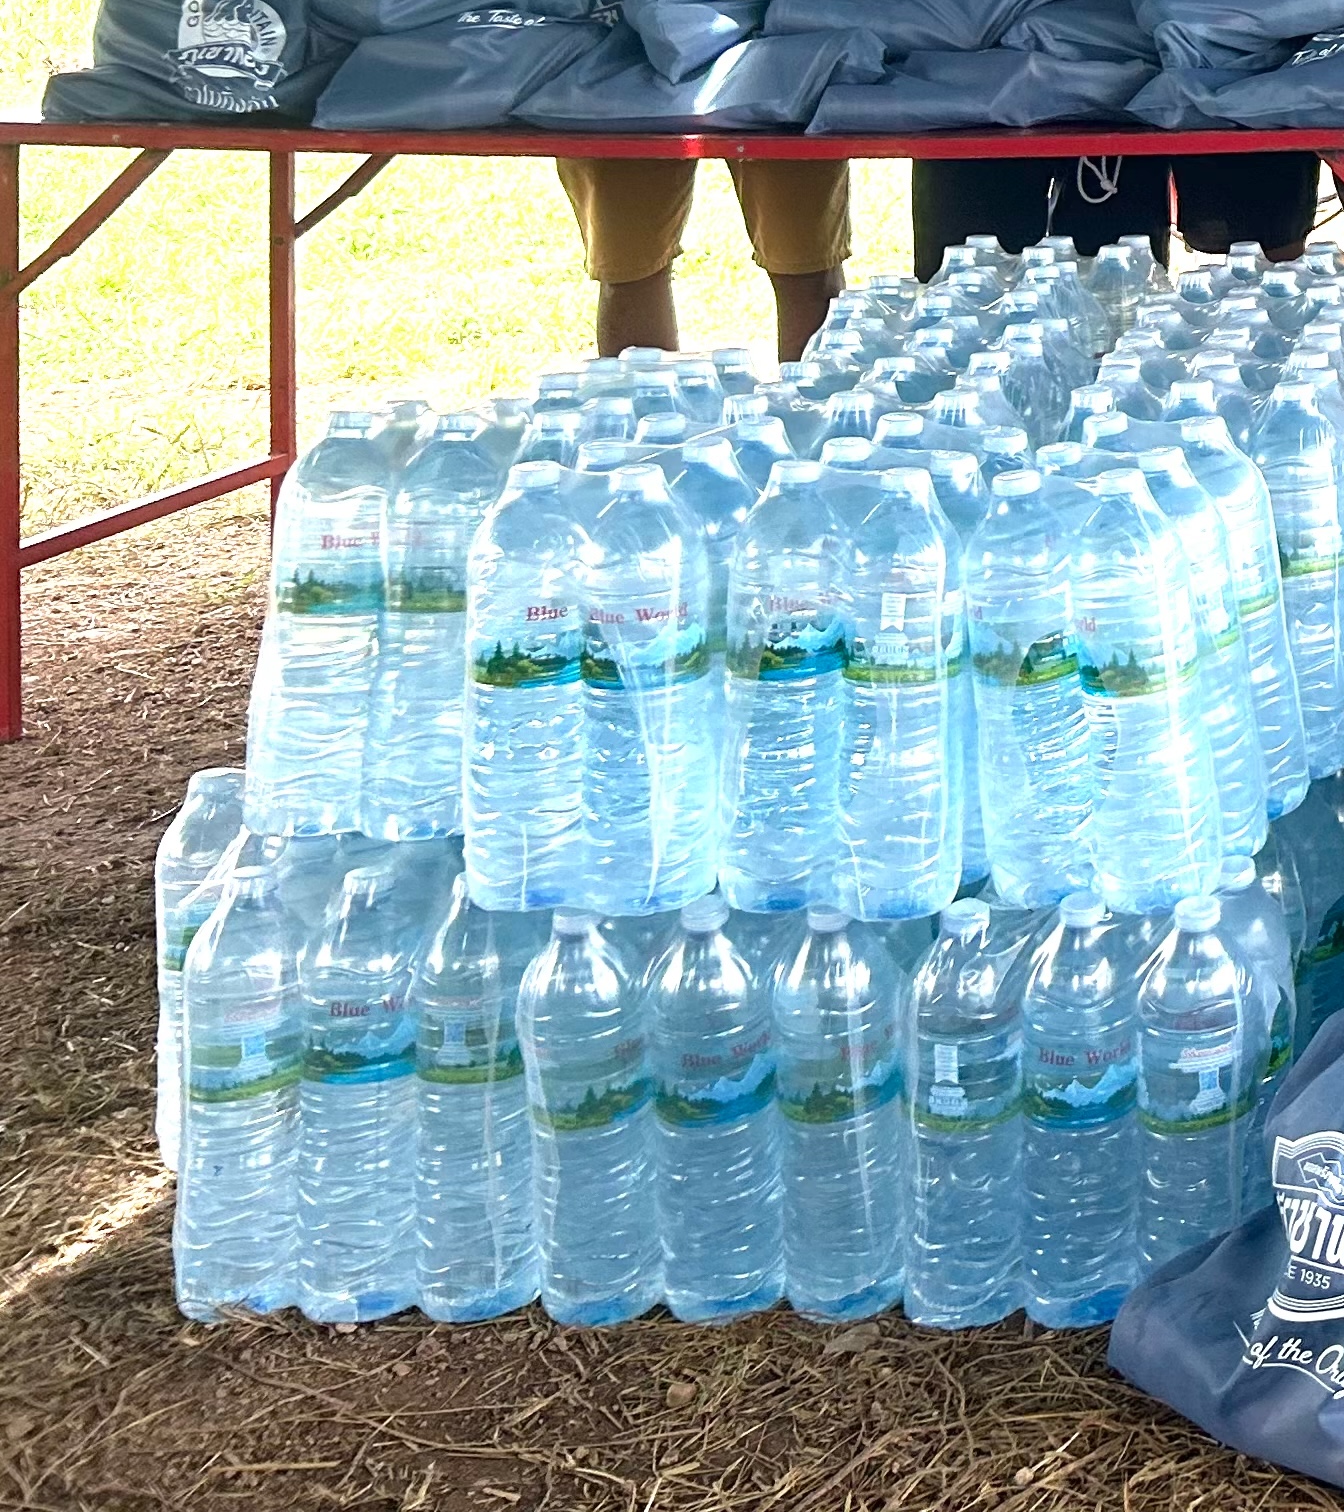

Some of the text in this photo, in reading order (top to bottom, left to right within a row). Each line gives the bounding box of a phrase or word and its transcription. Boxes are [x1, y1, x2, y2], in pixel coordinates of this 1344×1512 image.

[526, 605, 568, 622] Blue
[329, 1002, 370, 1019] Blue
[1038, 1046, 1075, 1067] Blue
[1301, 1268, 1331, 1290] 1935
[1249, 1339, 1270, 1368] of
[1280, 1336, 1313, 1365] the
